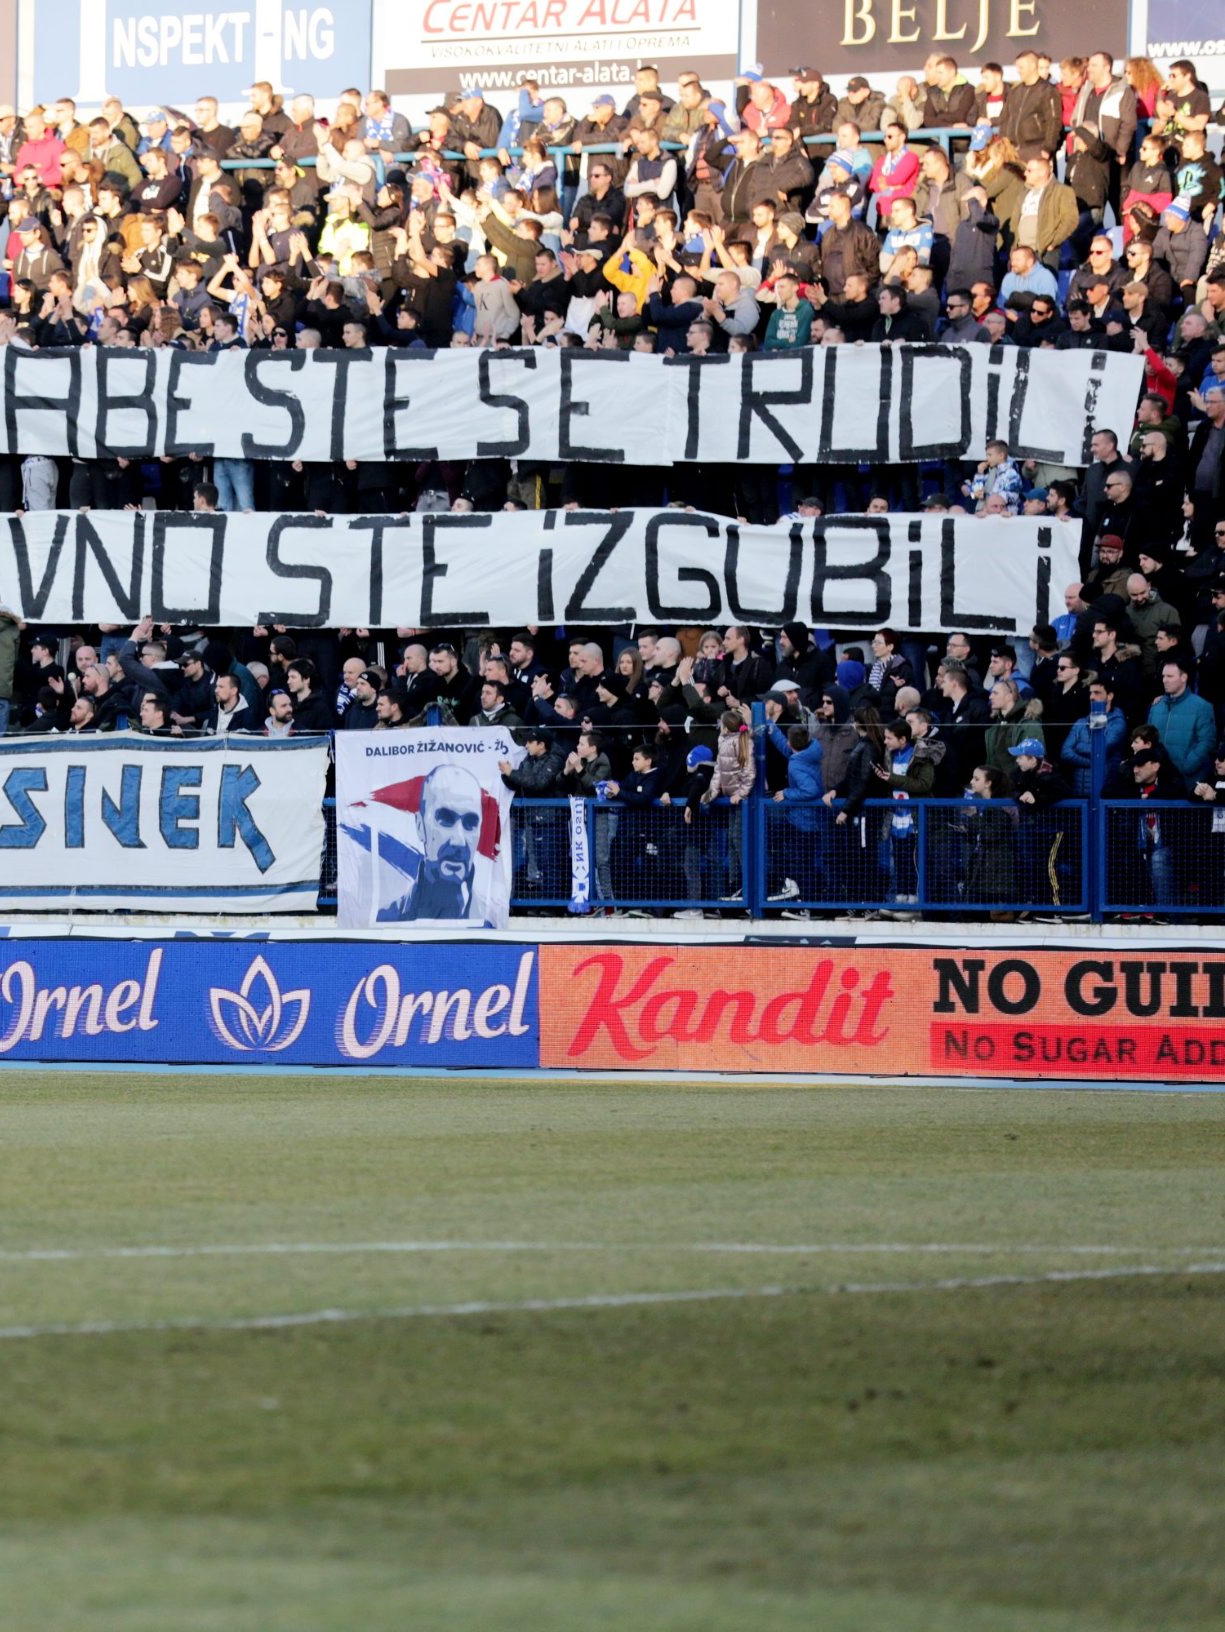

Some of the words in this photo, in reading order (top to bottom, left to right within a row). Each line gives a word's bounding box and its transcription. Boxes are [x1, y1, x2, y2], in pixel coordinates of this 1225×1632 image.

[422, 0, 568, 34] CENTAR
[577, 0, 698, 26] ALATA
[626, 35, 691, 50] OPREMA
[838, 0, 1041, 54] BELJE
[476, 347, 630, 463] SE
[258, 513, 492, 628] STE
[365, 744, 415, 757] DALIBOR
[341, 951, 535, 1059] Ornel
[567, 953, 895, 1061] Kandit
[933, 958, 1042, 1015] NO
